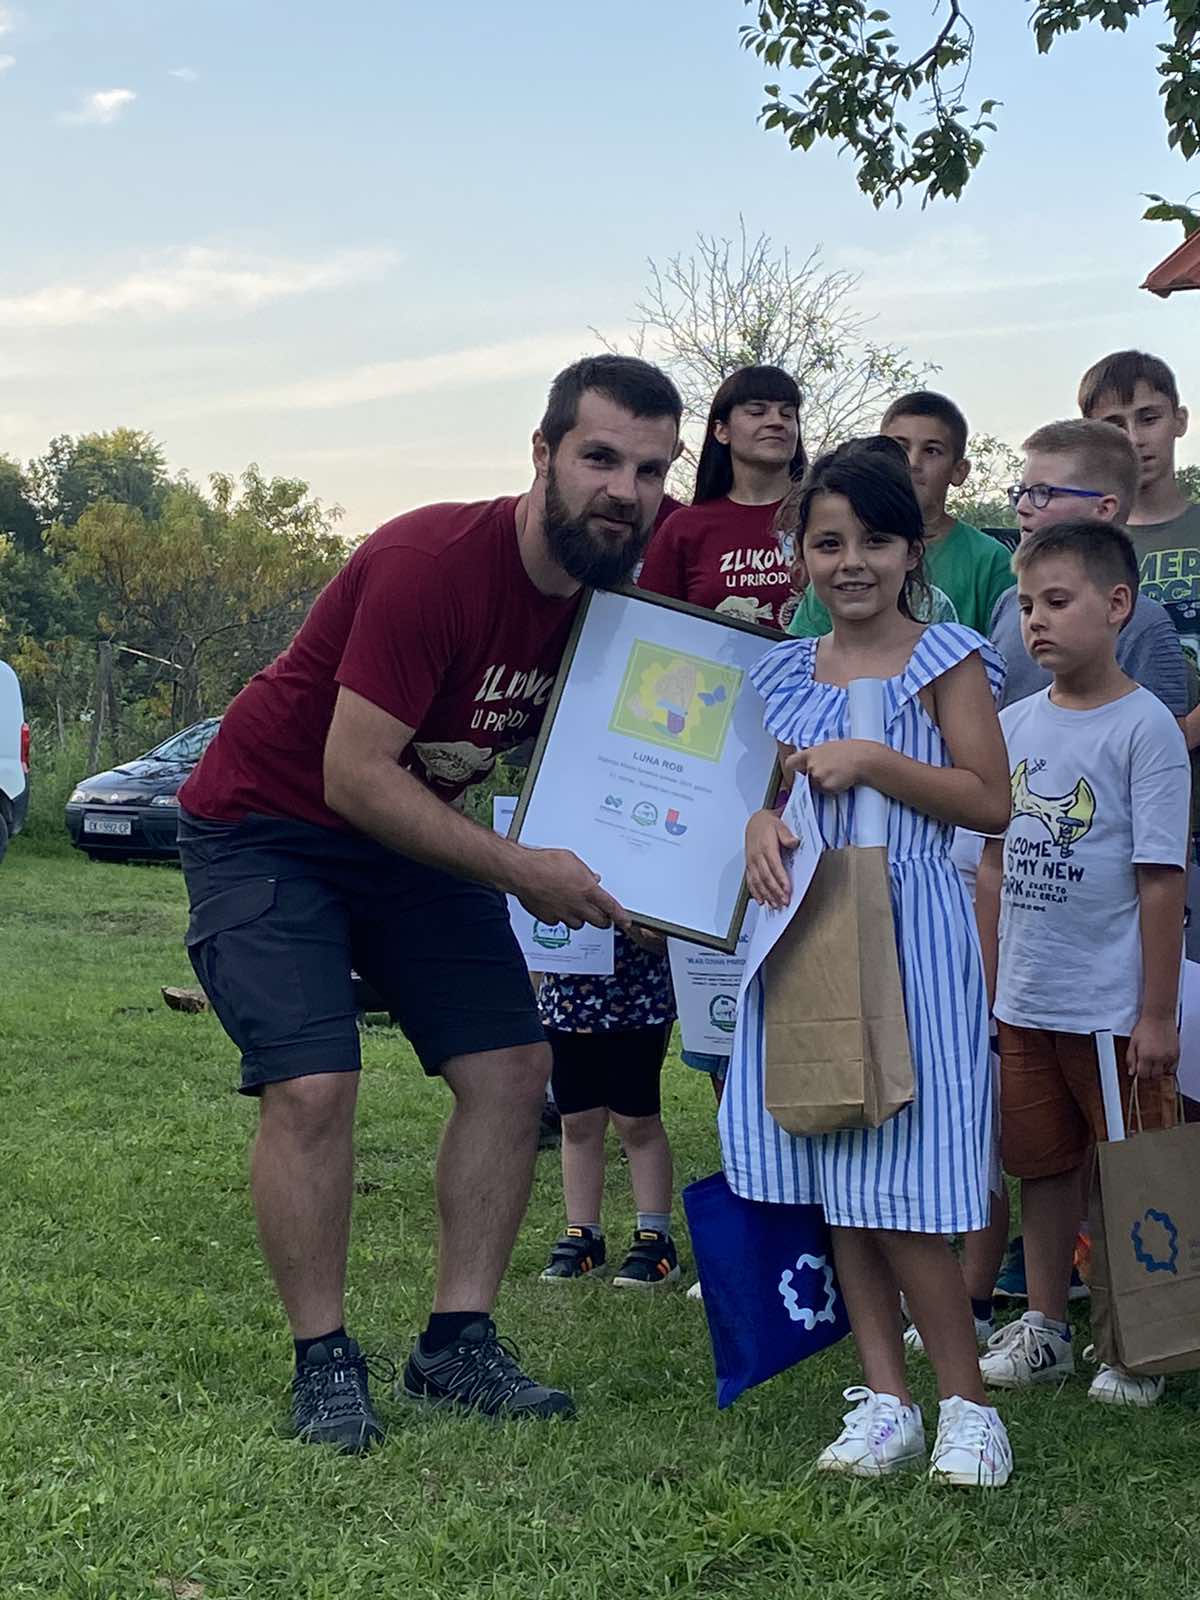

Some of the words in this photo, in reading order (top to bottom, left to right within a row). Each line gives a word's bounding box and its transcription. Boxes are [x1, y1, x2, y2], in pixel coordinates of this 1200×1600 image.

[726, 575, 736, 587] U
[470, 708, 483, 729] U
[632, 751, 660, 767] LUNA
[662, 759, 684, 773] ROB
[1016, 859, 1039, 876] MY
[1042, 862, 1085, 882] NEW
[1055, 886, 1067, 894] TO
